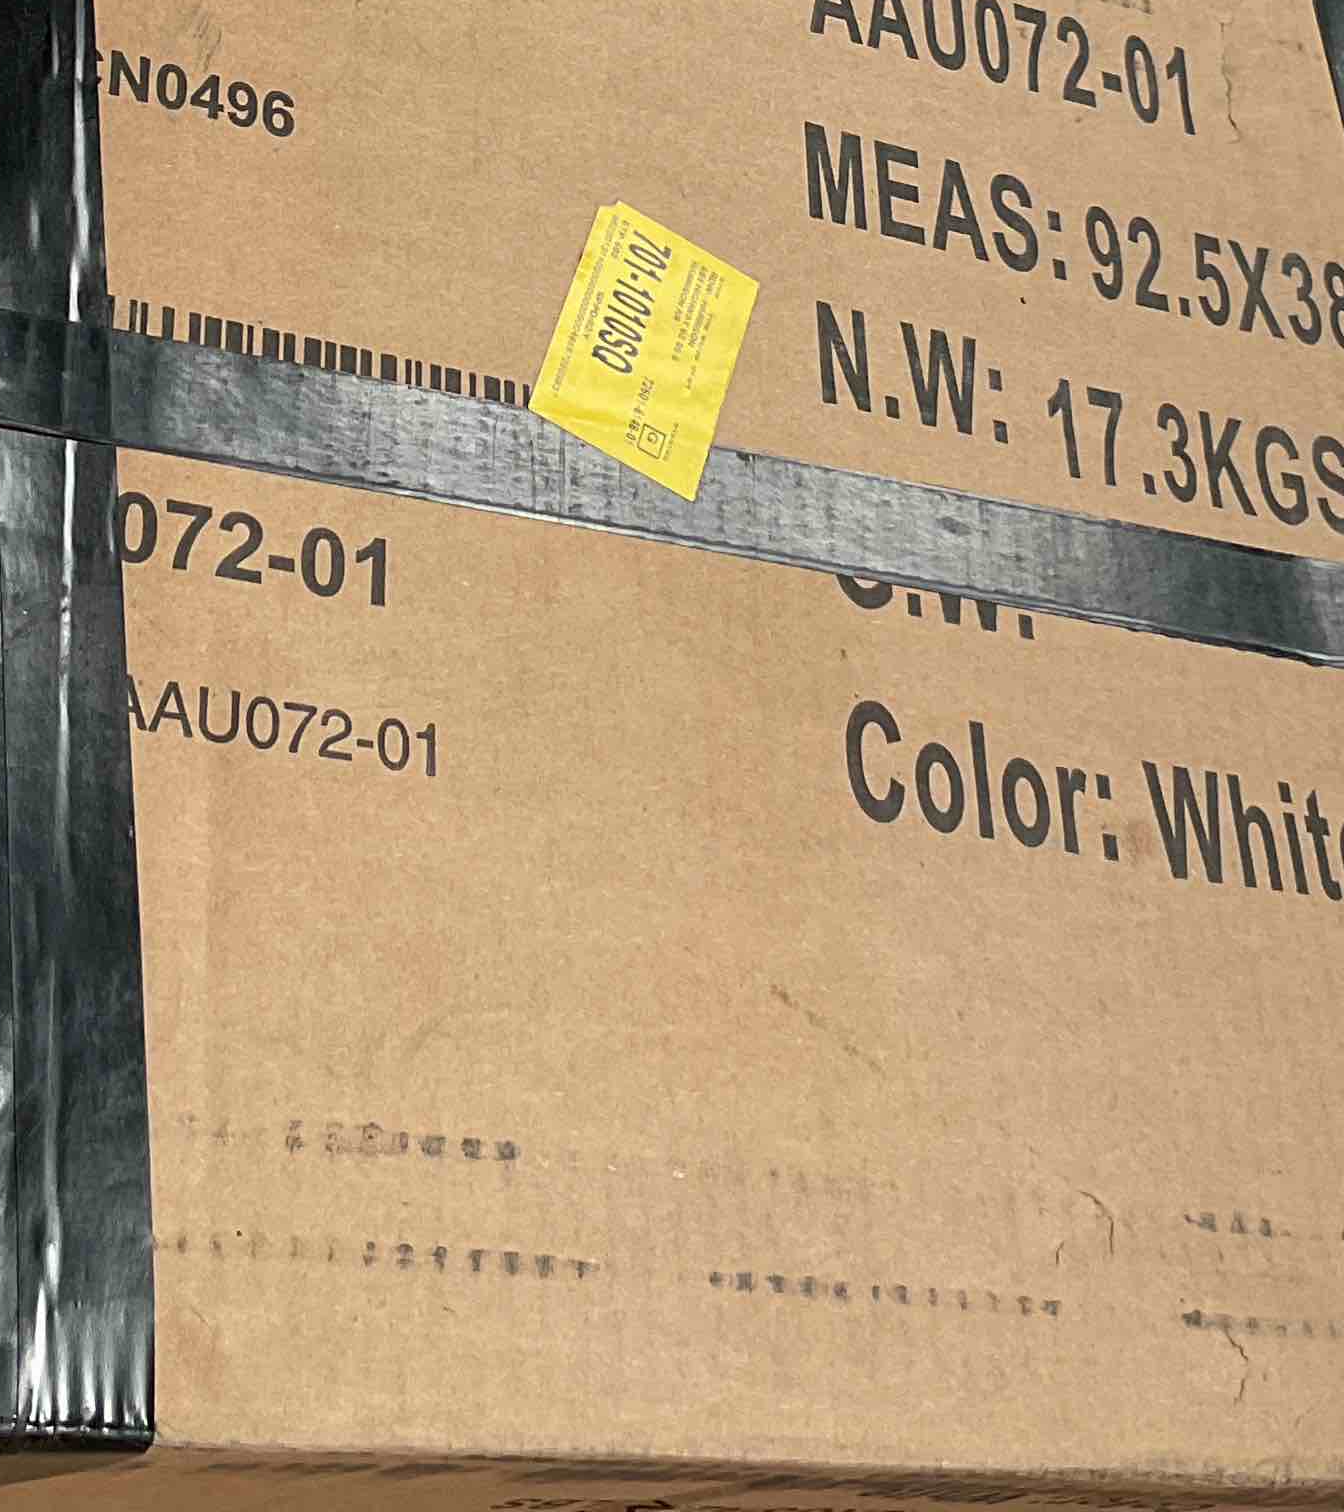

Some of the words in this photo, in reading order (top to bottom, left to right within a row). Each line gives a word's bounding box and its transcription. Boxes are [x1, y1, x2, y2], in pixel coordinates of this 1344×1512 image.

[804, 120, 1068, 282] MEAS:
[815, 300, 1009, 445] N.W:
[845, 699, 1120, 863] Color:
